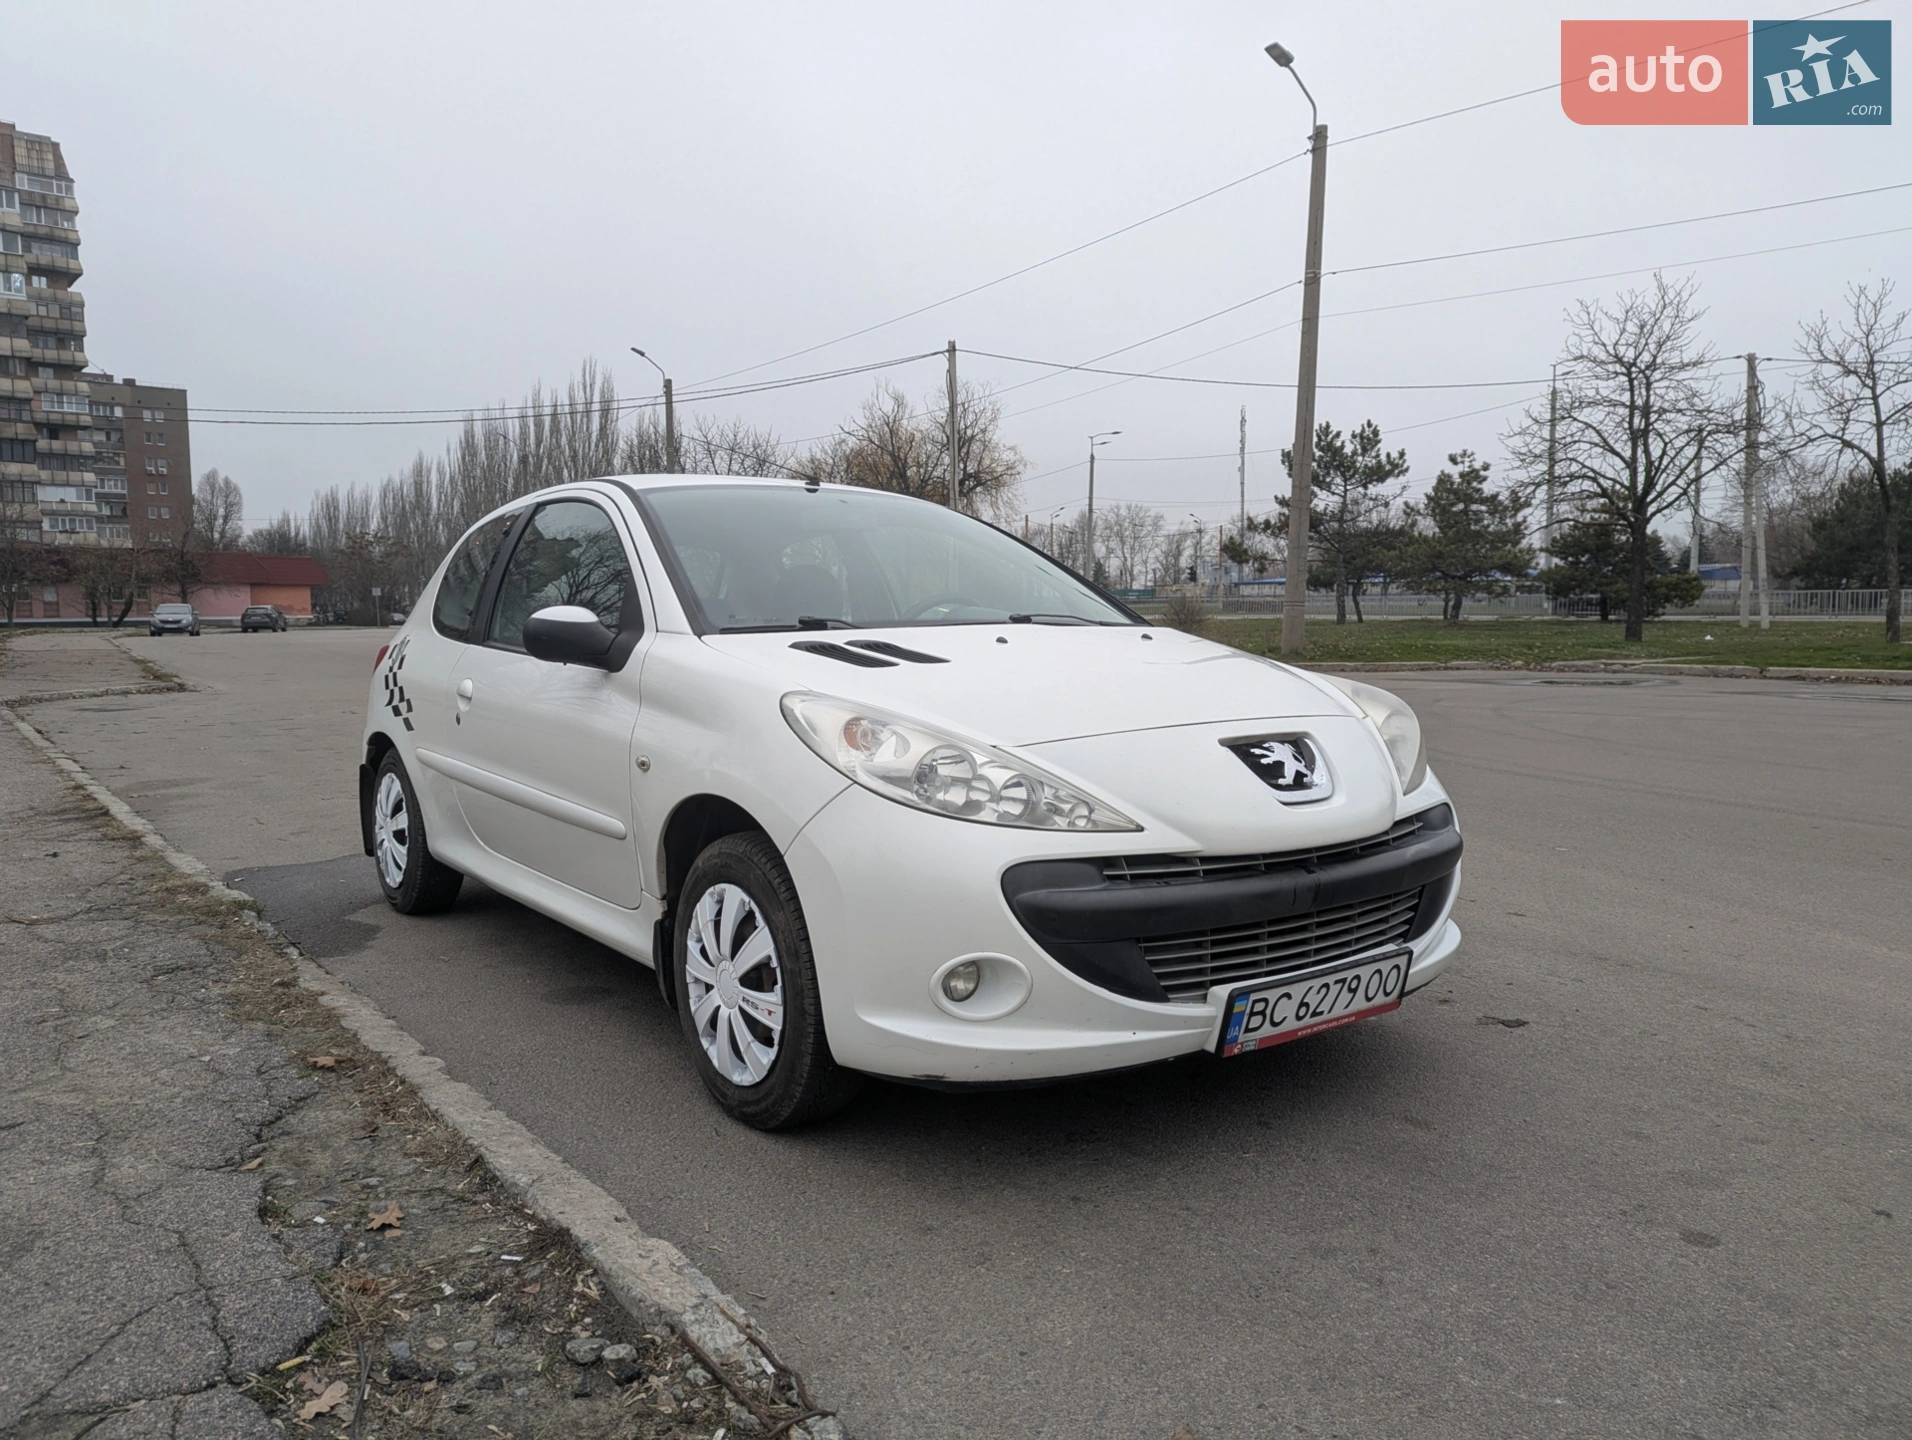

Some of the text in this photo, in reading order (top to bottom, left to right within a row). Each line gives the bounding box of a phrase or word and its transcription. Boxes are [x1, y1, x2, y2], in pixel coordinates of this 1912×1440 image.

[1243, 992, 1293, 1034] BC
[1295, 974, 1361, 1022] 6279
[1227, 1026, 1240, 1039] UA
